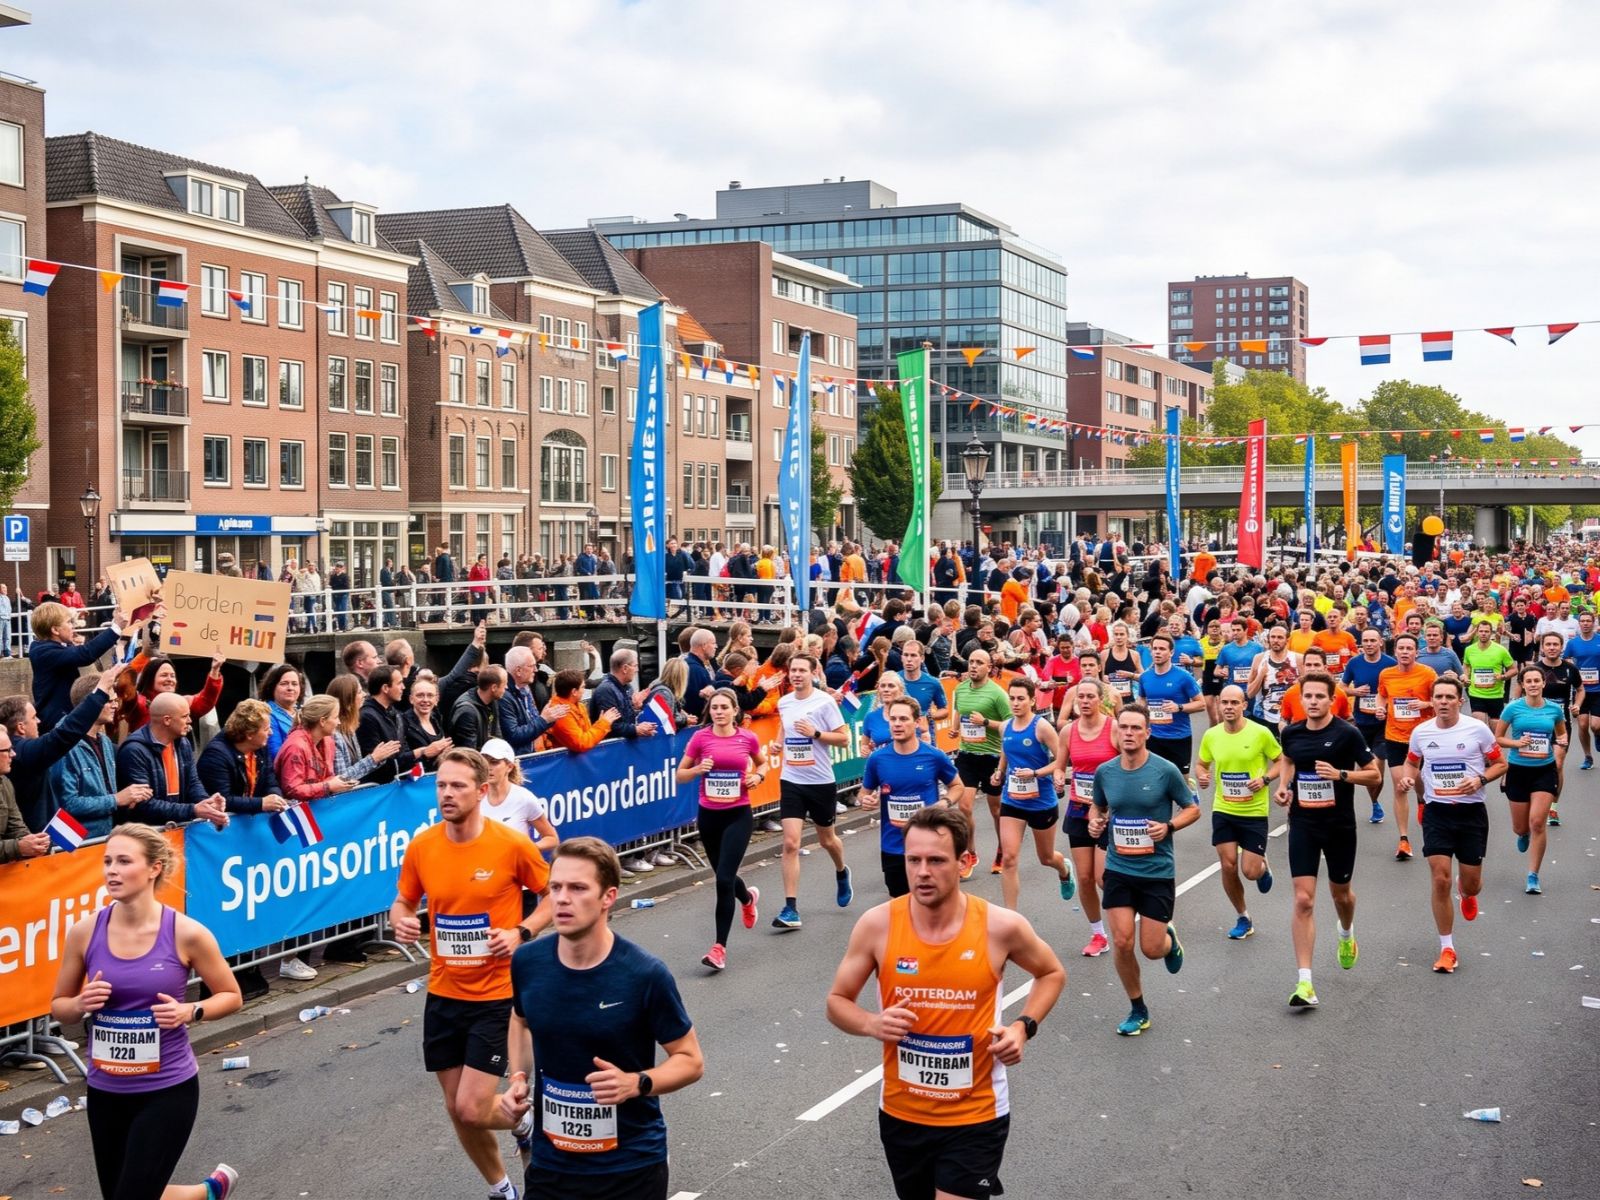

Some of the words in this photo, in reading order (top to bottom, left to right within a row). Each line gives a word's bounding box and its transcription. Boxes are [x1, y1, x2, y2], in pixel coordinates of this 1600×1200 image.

[10, 520, 23, 540] P
[174, 583, 243, 615] Borden
[200, 622, 219, 641] de
[451, 944, 472, 955] 1331
[895, 986, 977, 1001] ROTTERDAM
[919, 1070, 949, 1086] 1275
